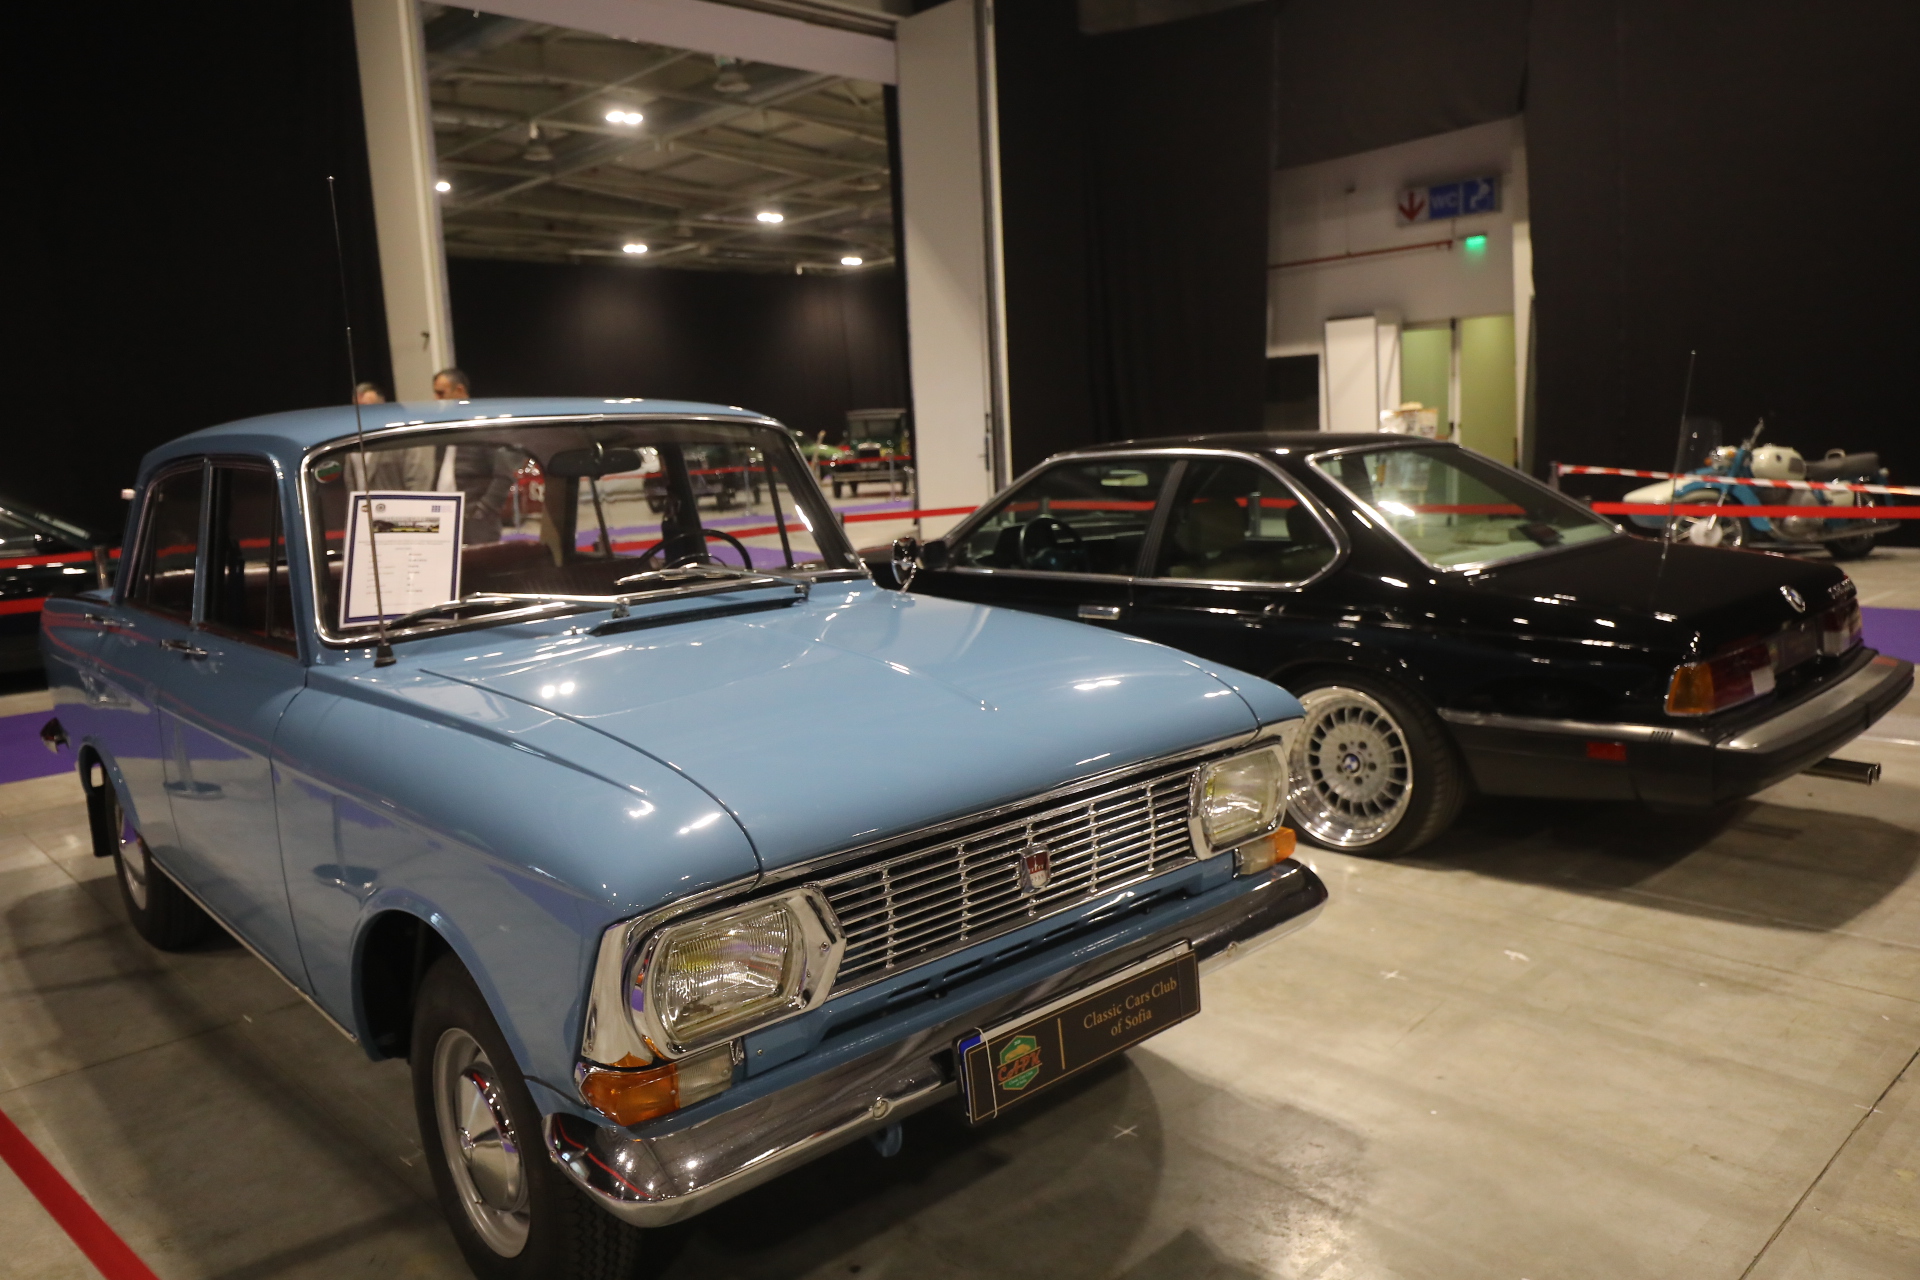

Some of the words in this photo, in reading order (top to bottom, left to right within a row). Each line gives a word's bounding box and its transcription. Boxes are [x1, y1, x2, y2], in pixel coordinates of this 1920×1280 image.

[1430, 191, 1458, 209] WC
[1083, 1003, 1122, 1029] Classic
[1125, 991, 1150, 1010] Cars
[1151, 976, 1177, 998] Club
[1110, 1018, 1123, 1037] of
[1124, 1008, 1153, 1030] Sofia
